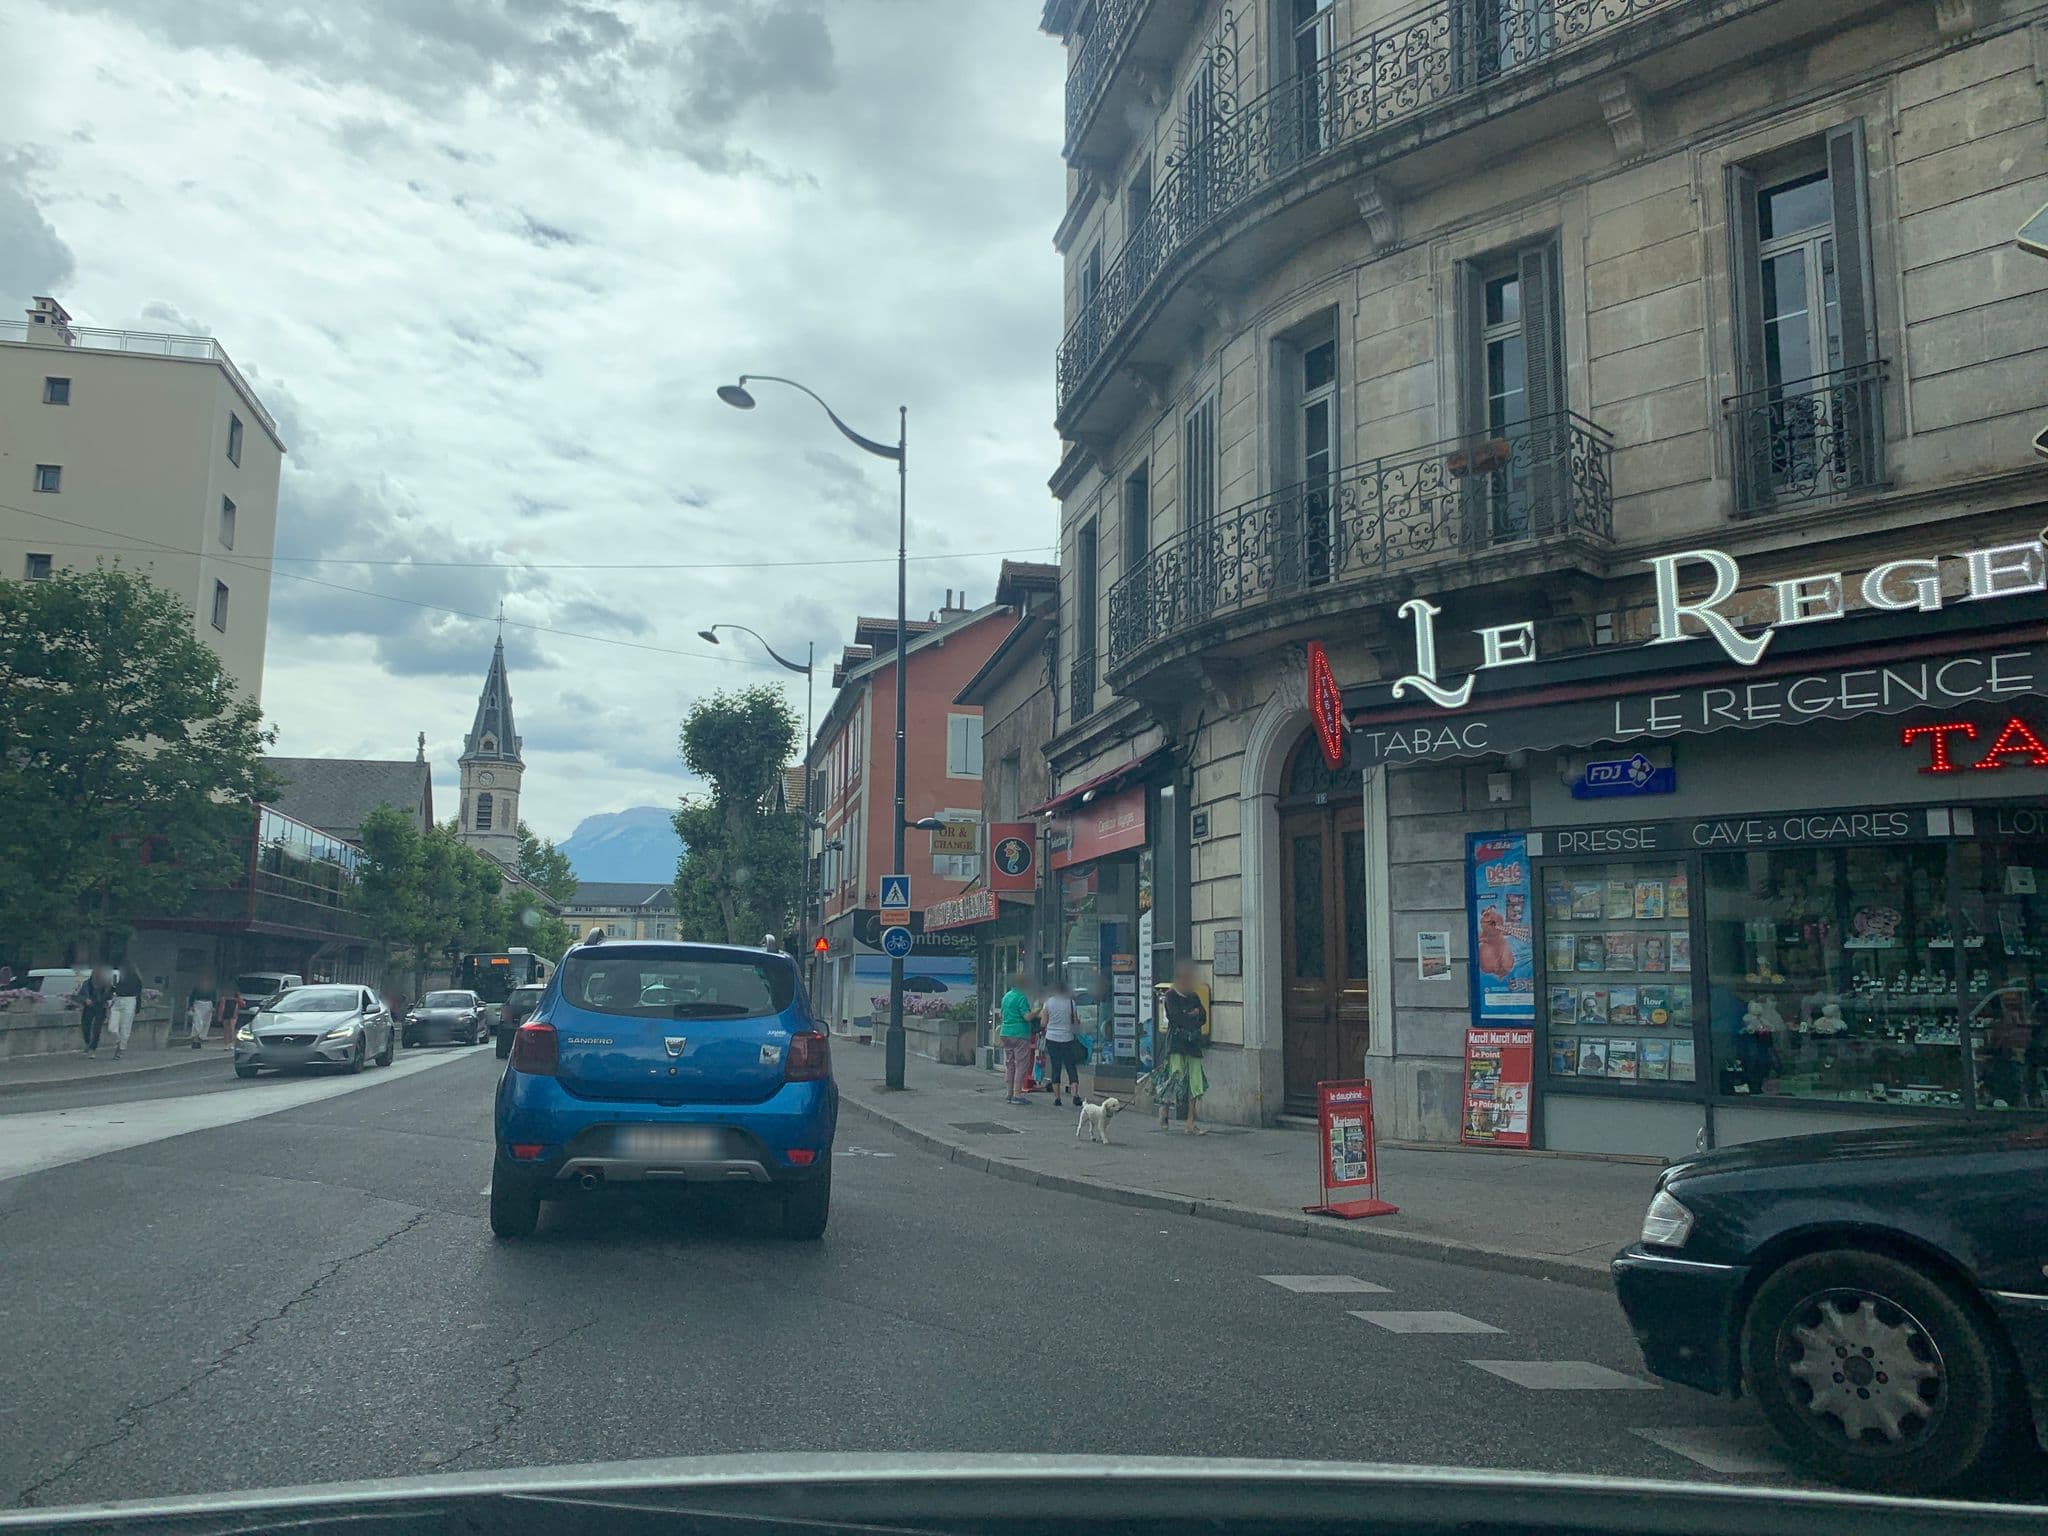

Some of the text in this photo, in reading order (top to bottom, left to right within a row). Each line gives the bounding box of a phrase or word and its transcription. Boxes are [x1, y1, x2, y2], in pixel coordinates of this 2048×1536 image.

[1615, 652, 2035, 735] LE REGENCE
[1320, 676, 1335, 734] TABAC
[1366, 722, 1488, 757] TABAC
[1902, 715, 2048, 774] TA
[1590, 764, 1622, 781] FDJ
[958, 827, 967, 838] &
[1557, 826, 1657, 852] PRESSE
[1693, 812, 1910, 846] CAVE à CIGARES
[934, 840, 973, 851] CHANGE
[567, 1037, 613, 1045] SANDERO
[1471, 1050, 1501, 1058] Le Point
[1469, 1099, 1477, 1107] Le
